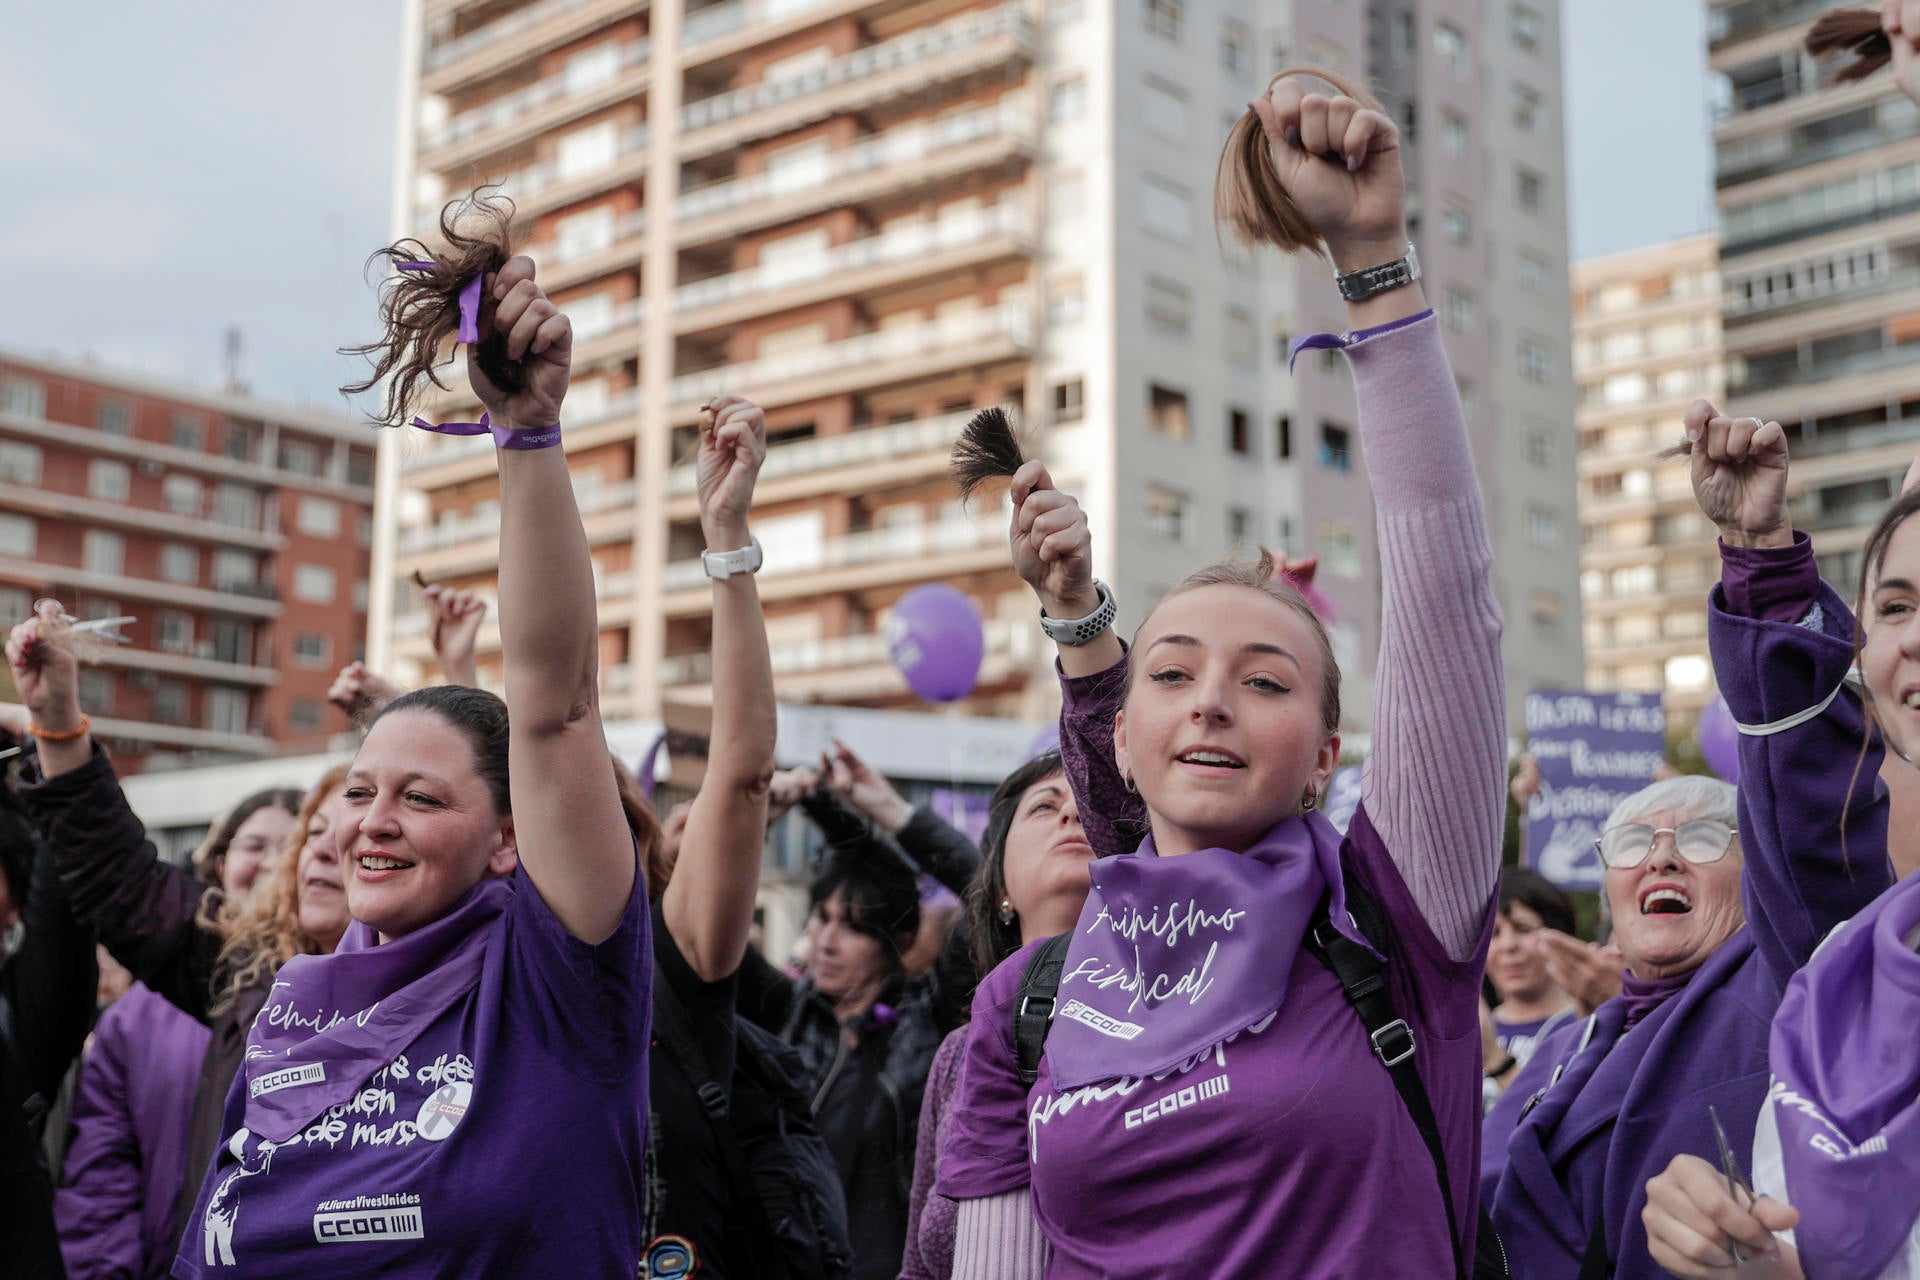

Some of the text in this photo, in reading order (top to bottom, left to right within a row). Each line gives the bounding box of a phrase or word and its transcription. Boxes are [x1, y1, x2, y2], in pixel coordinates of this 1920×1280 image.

[263, 1071, 301, 1090] CCOO
[416, 1053, 474, 1090] dies
[1125, 1086, 1197, 1129] CCOO
[304, 1115, 347, 1149] de
[319, 1217, 388, 1238] CCOO
